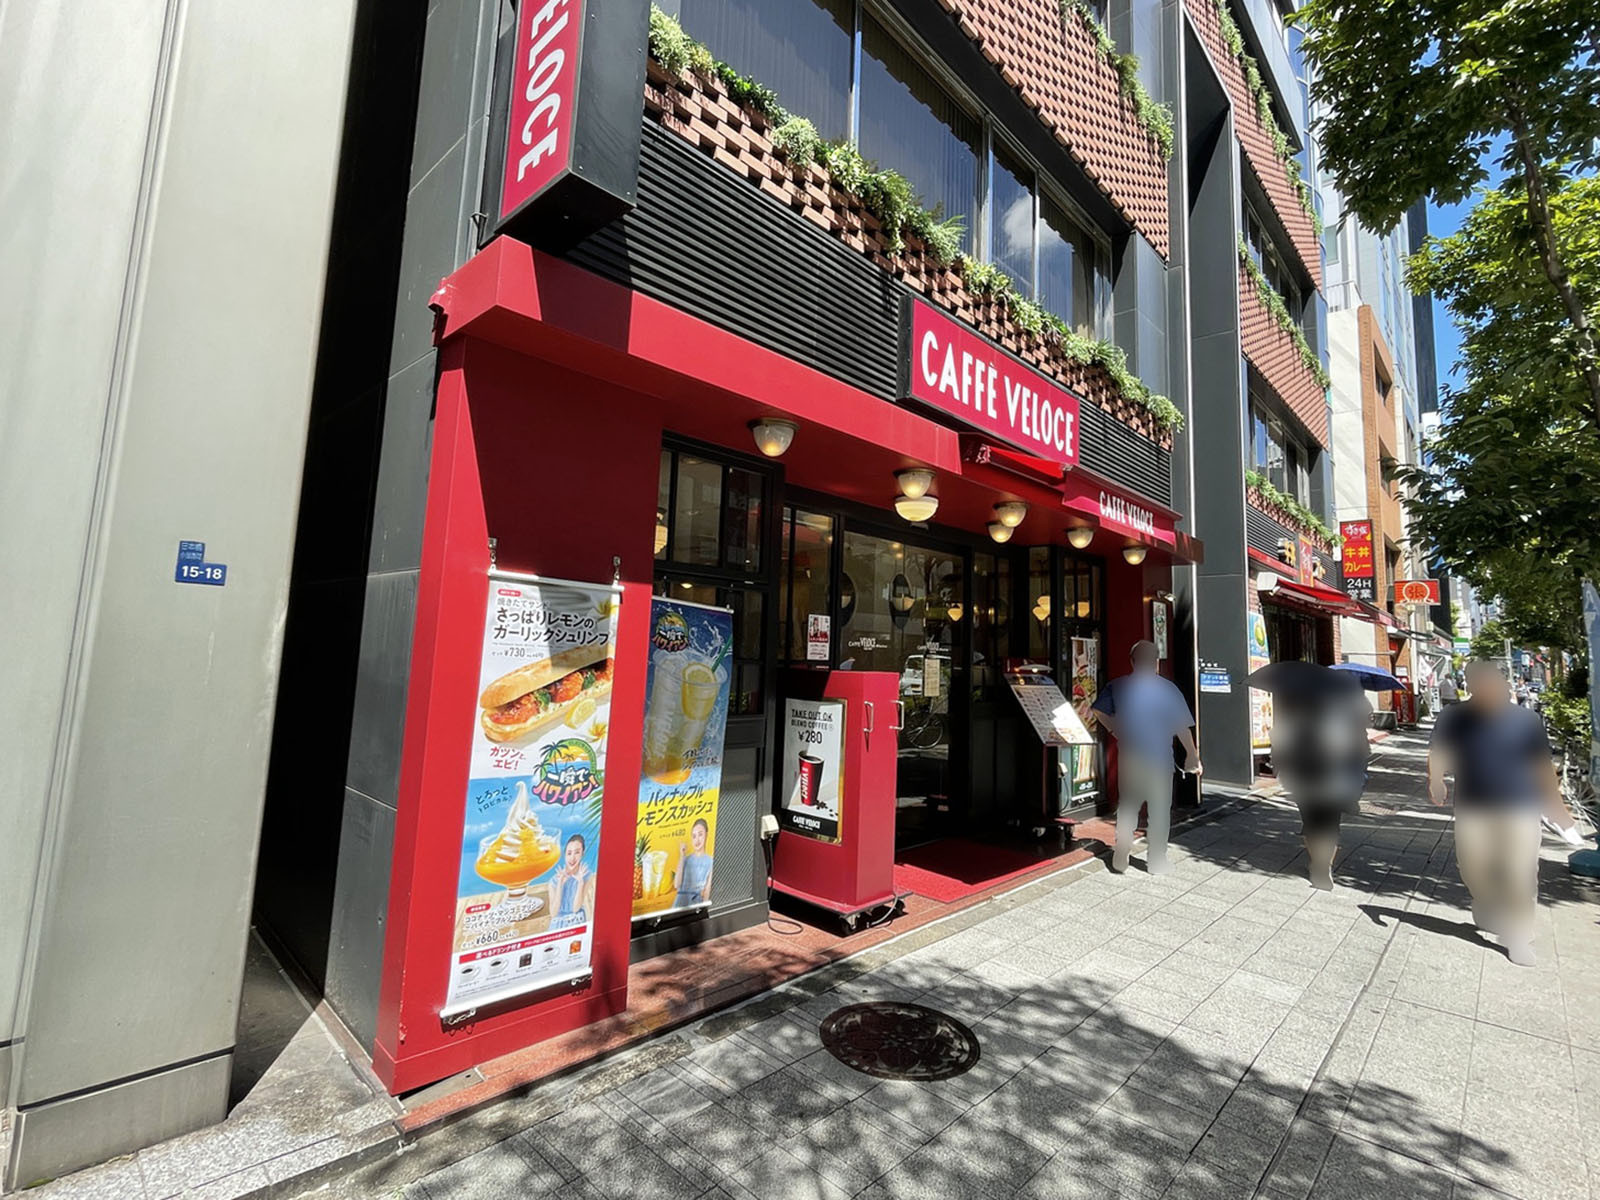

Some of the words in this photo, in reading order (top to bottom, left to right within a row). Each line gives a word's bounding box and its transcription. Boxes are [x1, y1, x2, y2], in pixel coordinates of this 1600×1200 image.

[921, 330, 997, 419] CAFFÈ
[1004, 375, 1074, 457] VELOCE
[1126, 502, 1154, 535] VELOCE
[182, 565, 222, 580] 15-18
[1345, 562, 1371, 573] カレー
[1347, 579, 1372, 588] 24H
[792, 709, 807, 719] TAKE
[808, 711, 821, 720] OUT
[823, 712, 833, 721] OK
[798, 730, 822, 744] ¥280
[475, 785, 509, 805] とろっと
[476, 930, 498, 945] ¥660
